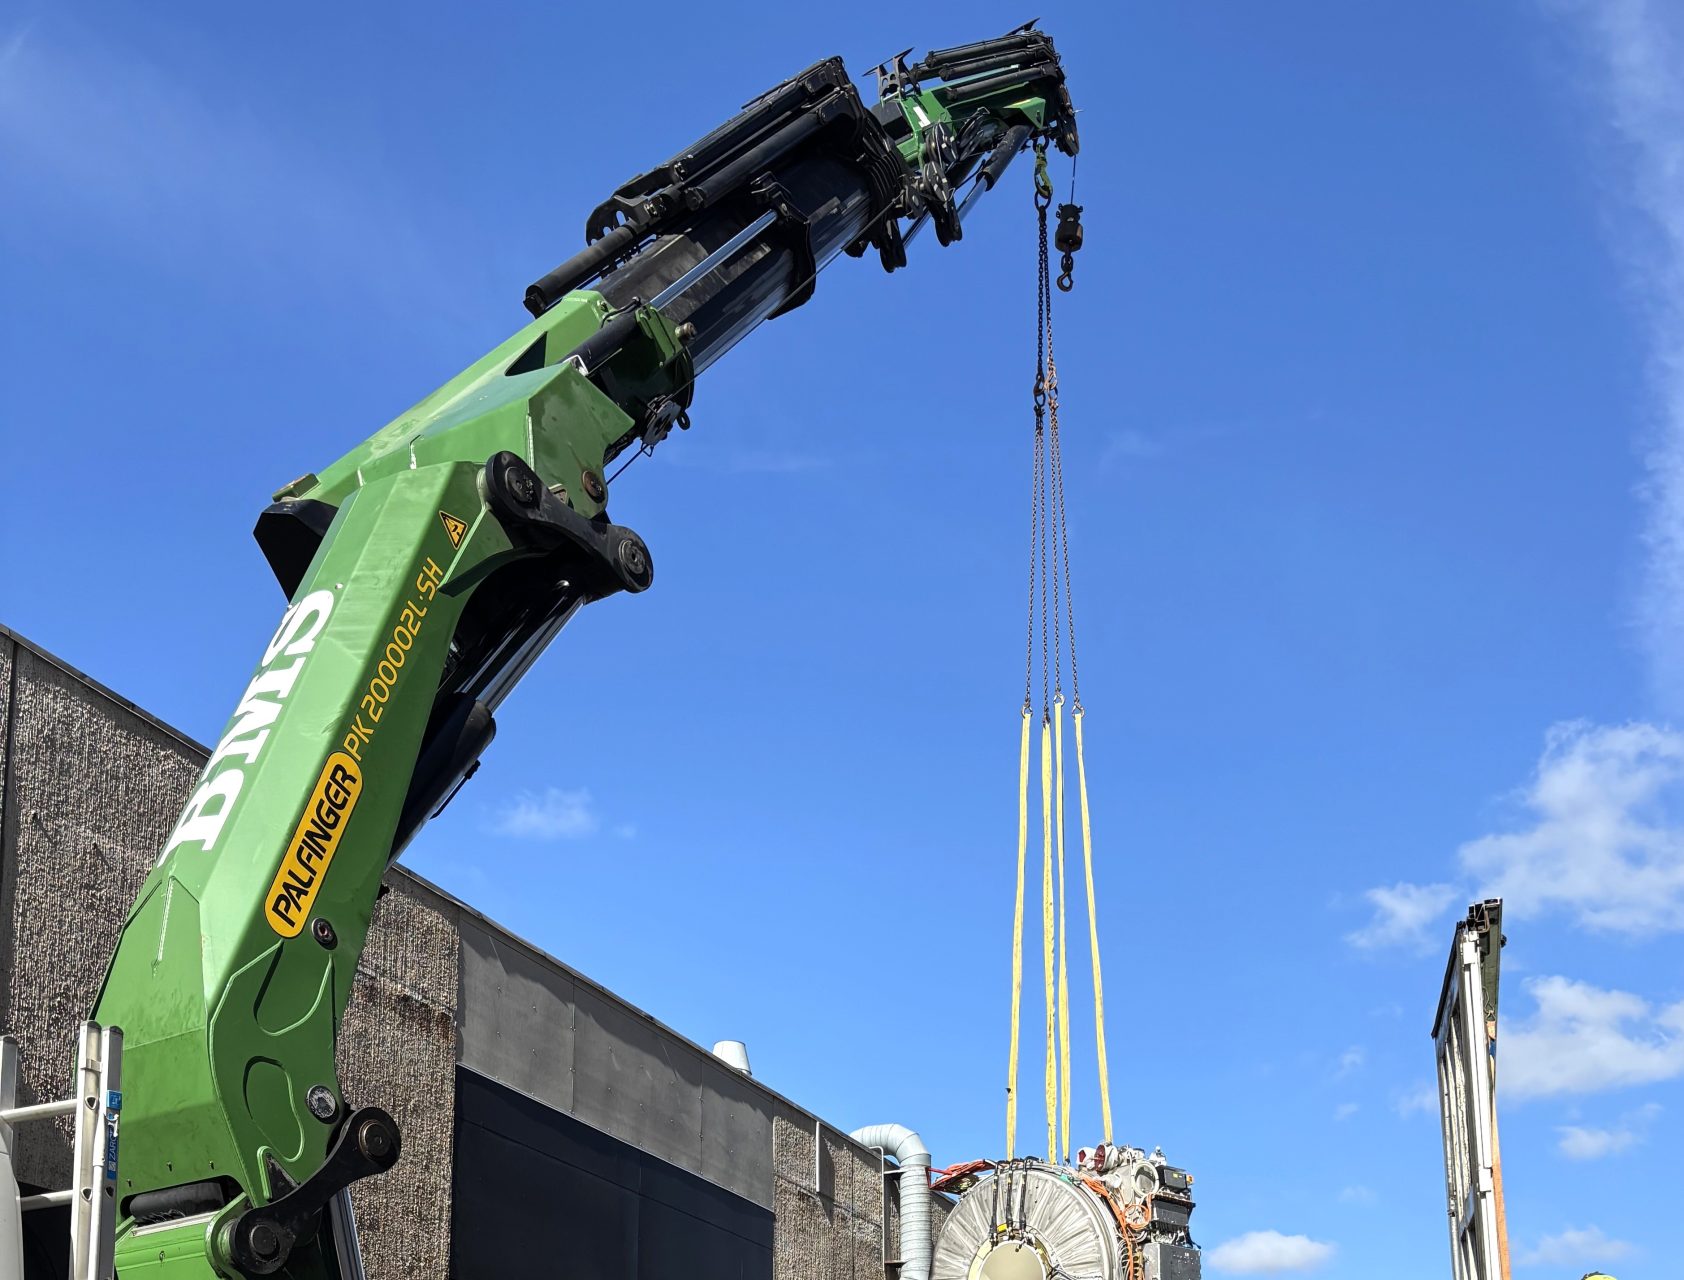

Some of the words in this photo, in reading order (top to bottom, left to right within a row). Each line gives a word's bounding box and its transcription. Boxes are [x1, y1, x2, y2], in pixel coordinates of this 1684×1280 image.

[156, 589, 334, 868] BMS
[344, 713, 374, 761] PK
[272, 763, 358, 927] PALFINGER
